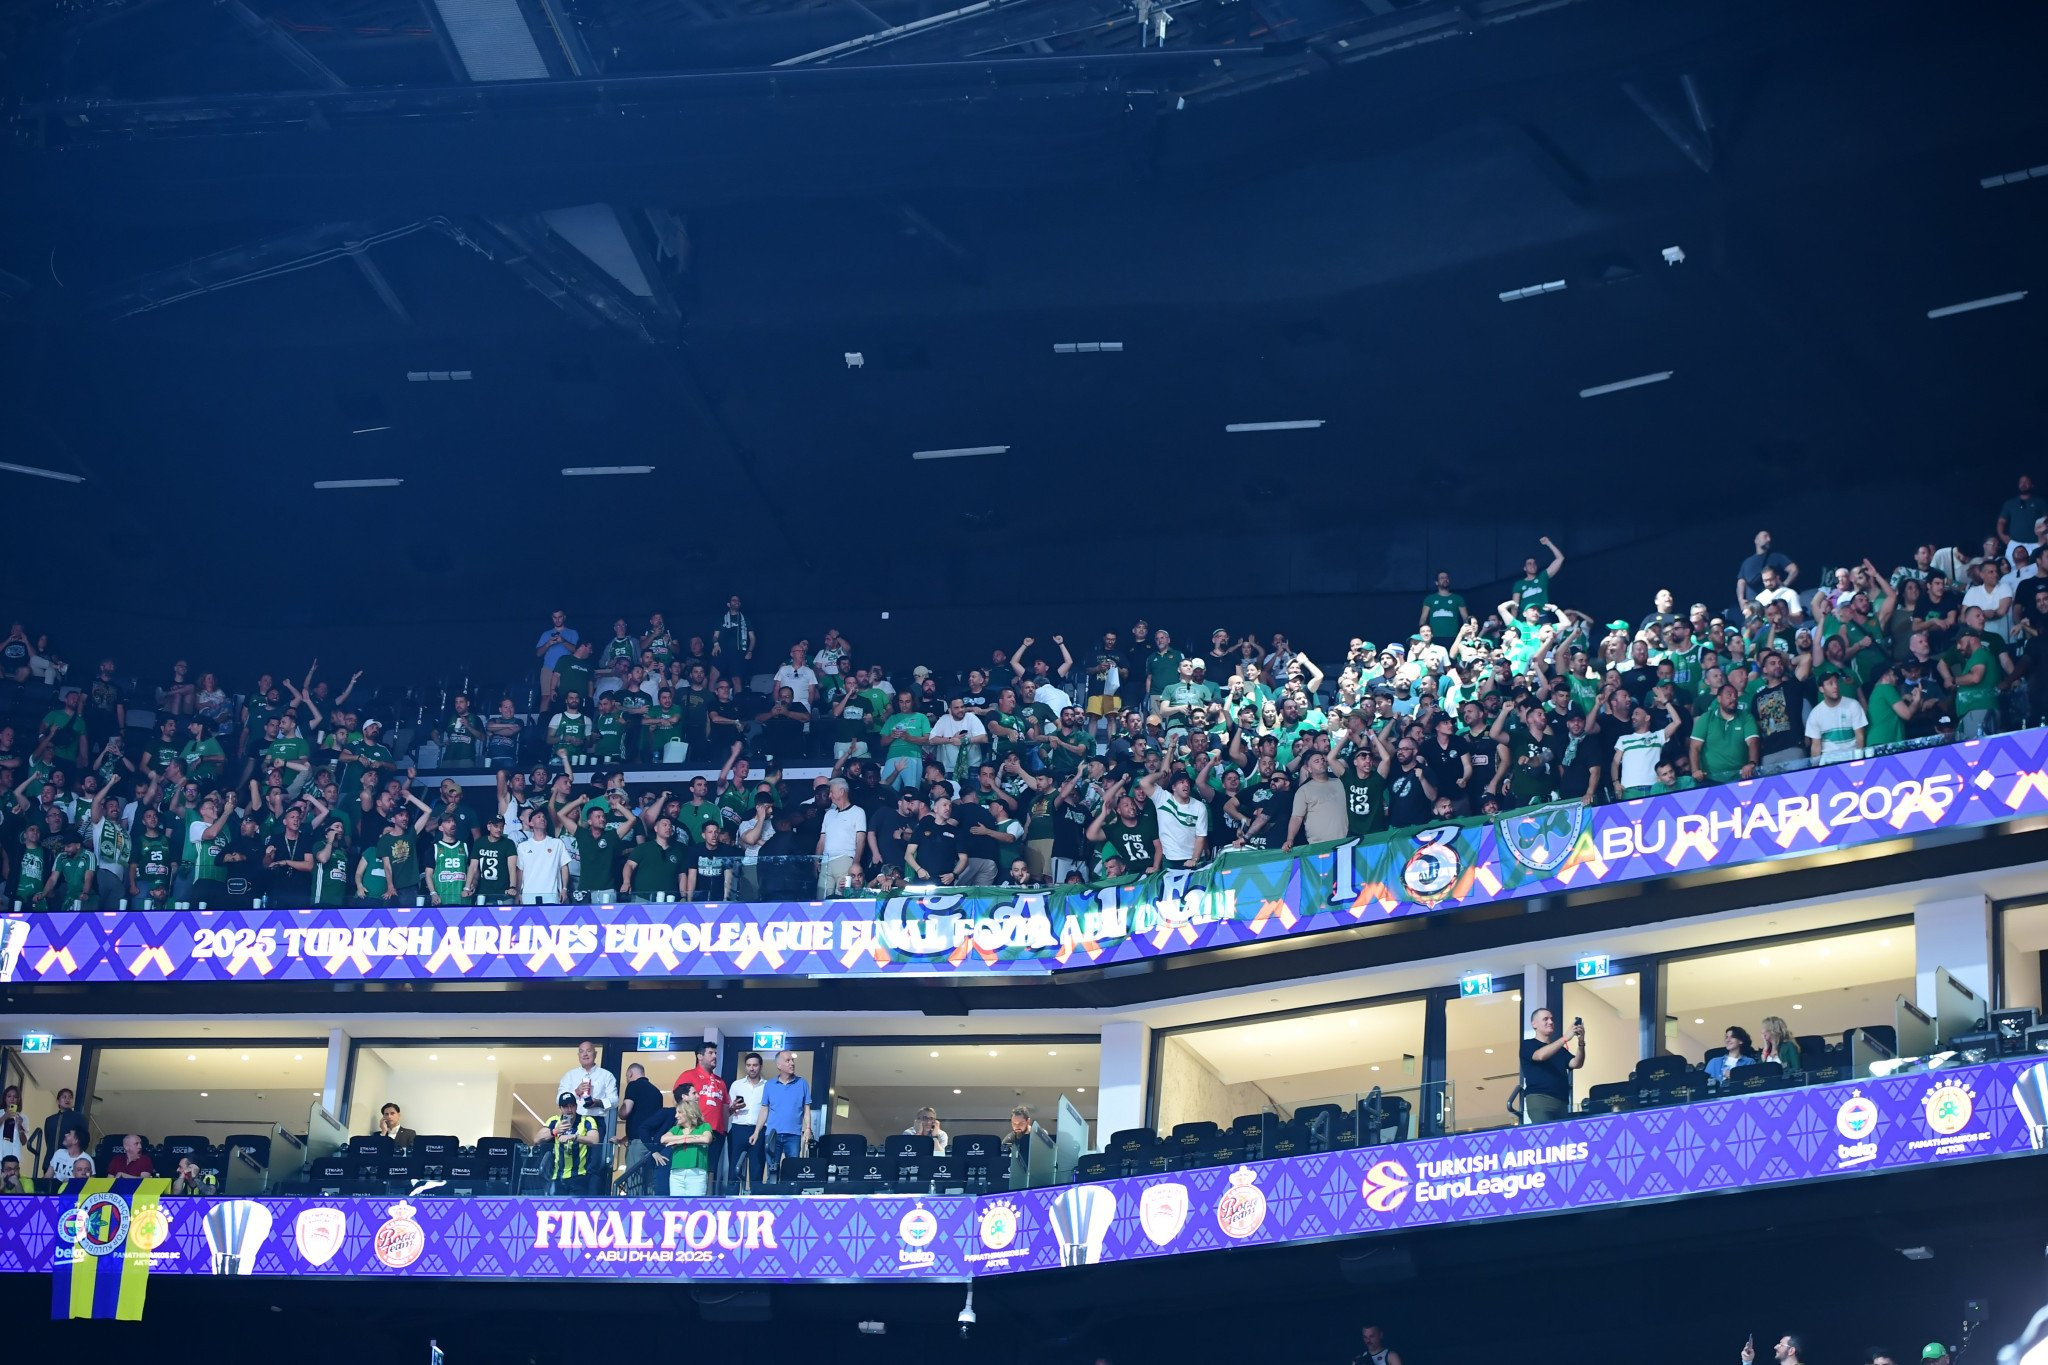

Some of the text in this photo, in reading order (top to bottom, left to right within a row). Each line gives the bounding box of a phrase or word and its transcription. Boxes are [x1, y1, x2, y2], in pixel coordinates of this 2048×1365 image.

[566, 725, 579, 734] 25
[1829, 774, 1954, 826] 2025
[151, 850, 163, 861] 25
[479, 848, 498, 858] GATE
[1124, 842, 1150, 861] 13
[444, 857, 461, 869] 26
[479, 858, 499, 881] 13
[191, 927, 277, 958] 2025
[282, 926, 435, 957] TURKISH
[437, 924, 598, 956] AIRLINES
[603, 921, 834, 953] EUROLEAGUE
[1416, 1142, 1589, 1180] TURKISH AIRLINES
[1415, 1171, 1546, 1203] EuroLeague
[88, 1193, 130, 1221] FENERBAHÇE
[112, 1223, 129, 1249] SPOR
[533, 1209, 778, 1249] FINAL FOUR
[55, 1246, 87, 1259] beko
[596, 1251, 713, 1262] ABU DHABI 2025
